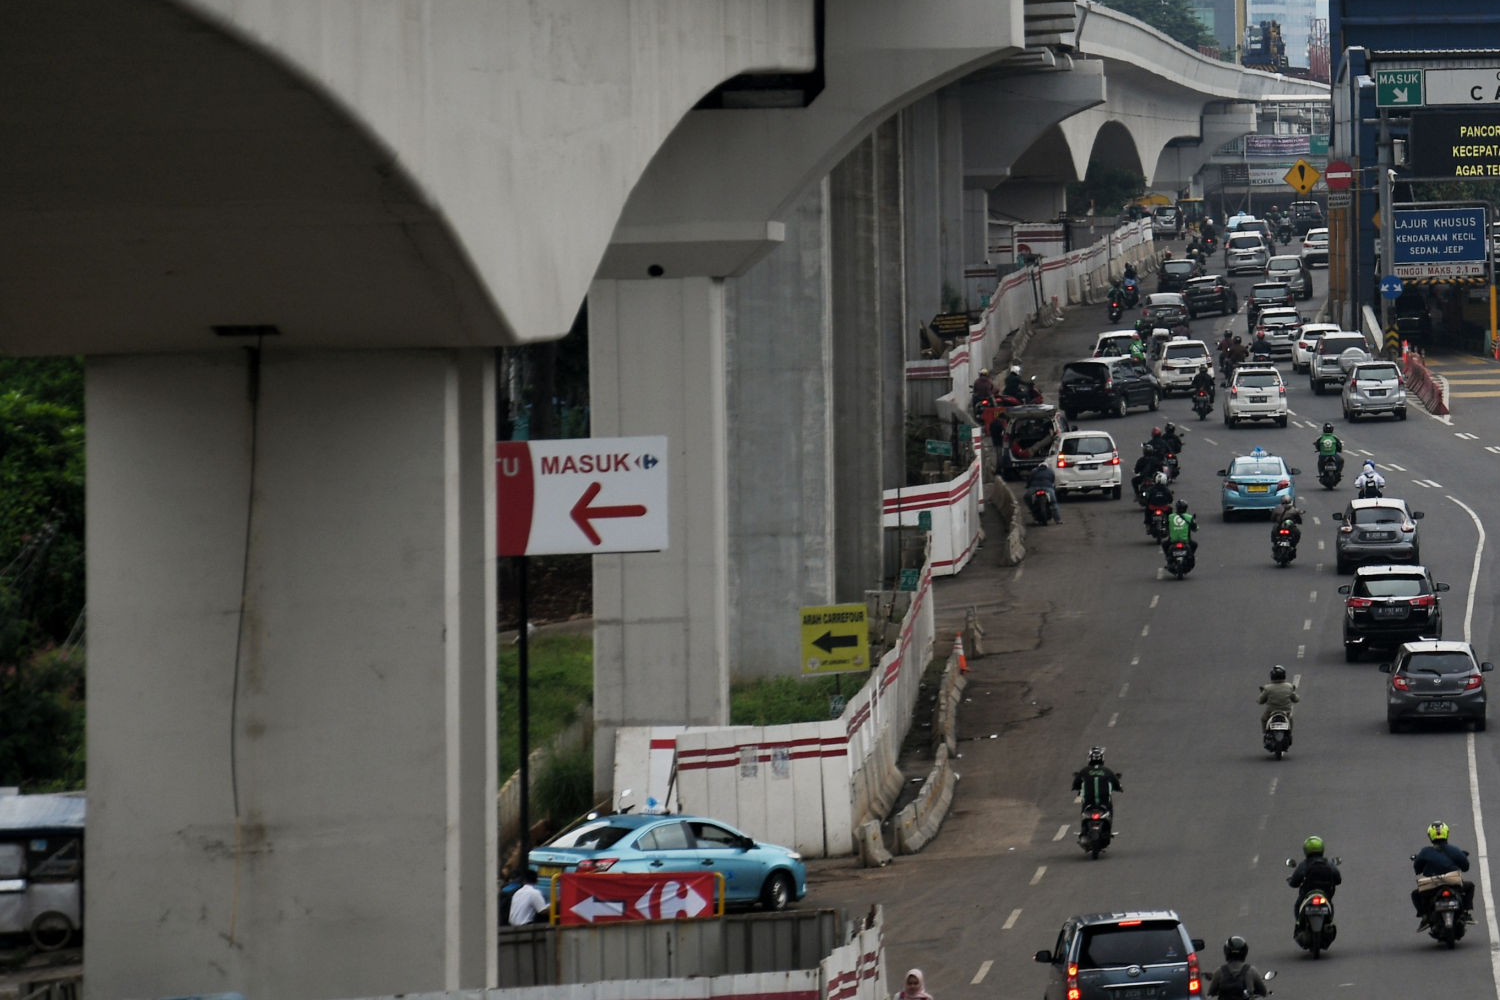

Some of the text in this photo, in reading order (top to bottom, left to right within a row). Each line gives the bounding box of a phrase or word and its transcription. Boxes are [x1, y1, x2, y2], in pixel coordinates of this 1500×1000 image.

[1379, 73, 1419, 85] MASUK
[1455, 164, 1484, 176] AGAR
[1394, 216, 1477, 230] LAJUR KHUSUS
[1396, 231, 1476, 243] KENDARAAN KECIL
[1443, 245, 1464, 255] JEEP
[1396, 267, 1424, 277] TINGGI
[540, 452, 631, 476] MASUK
